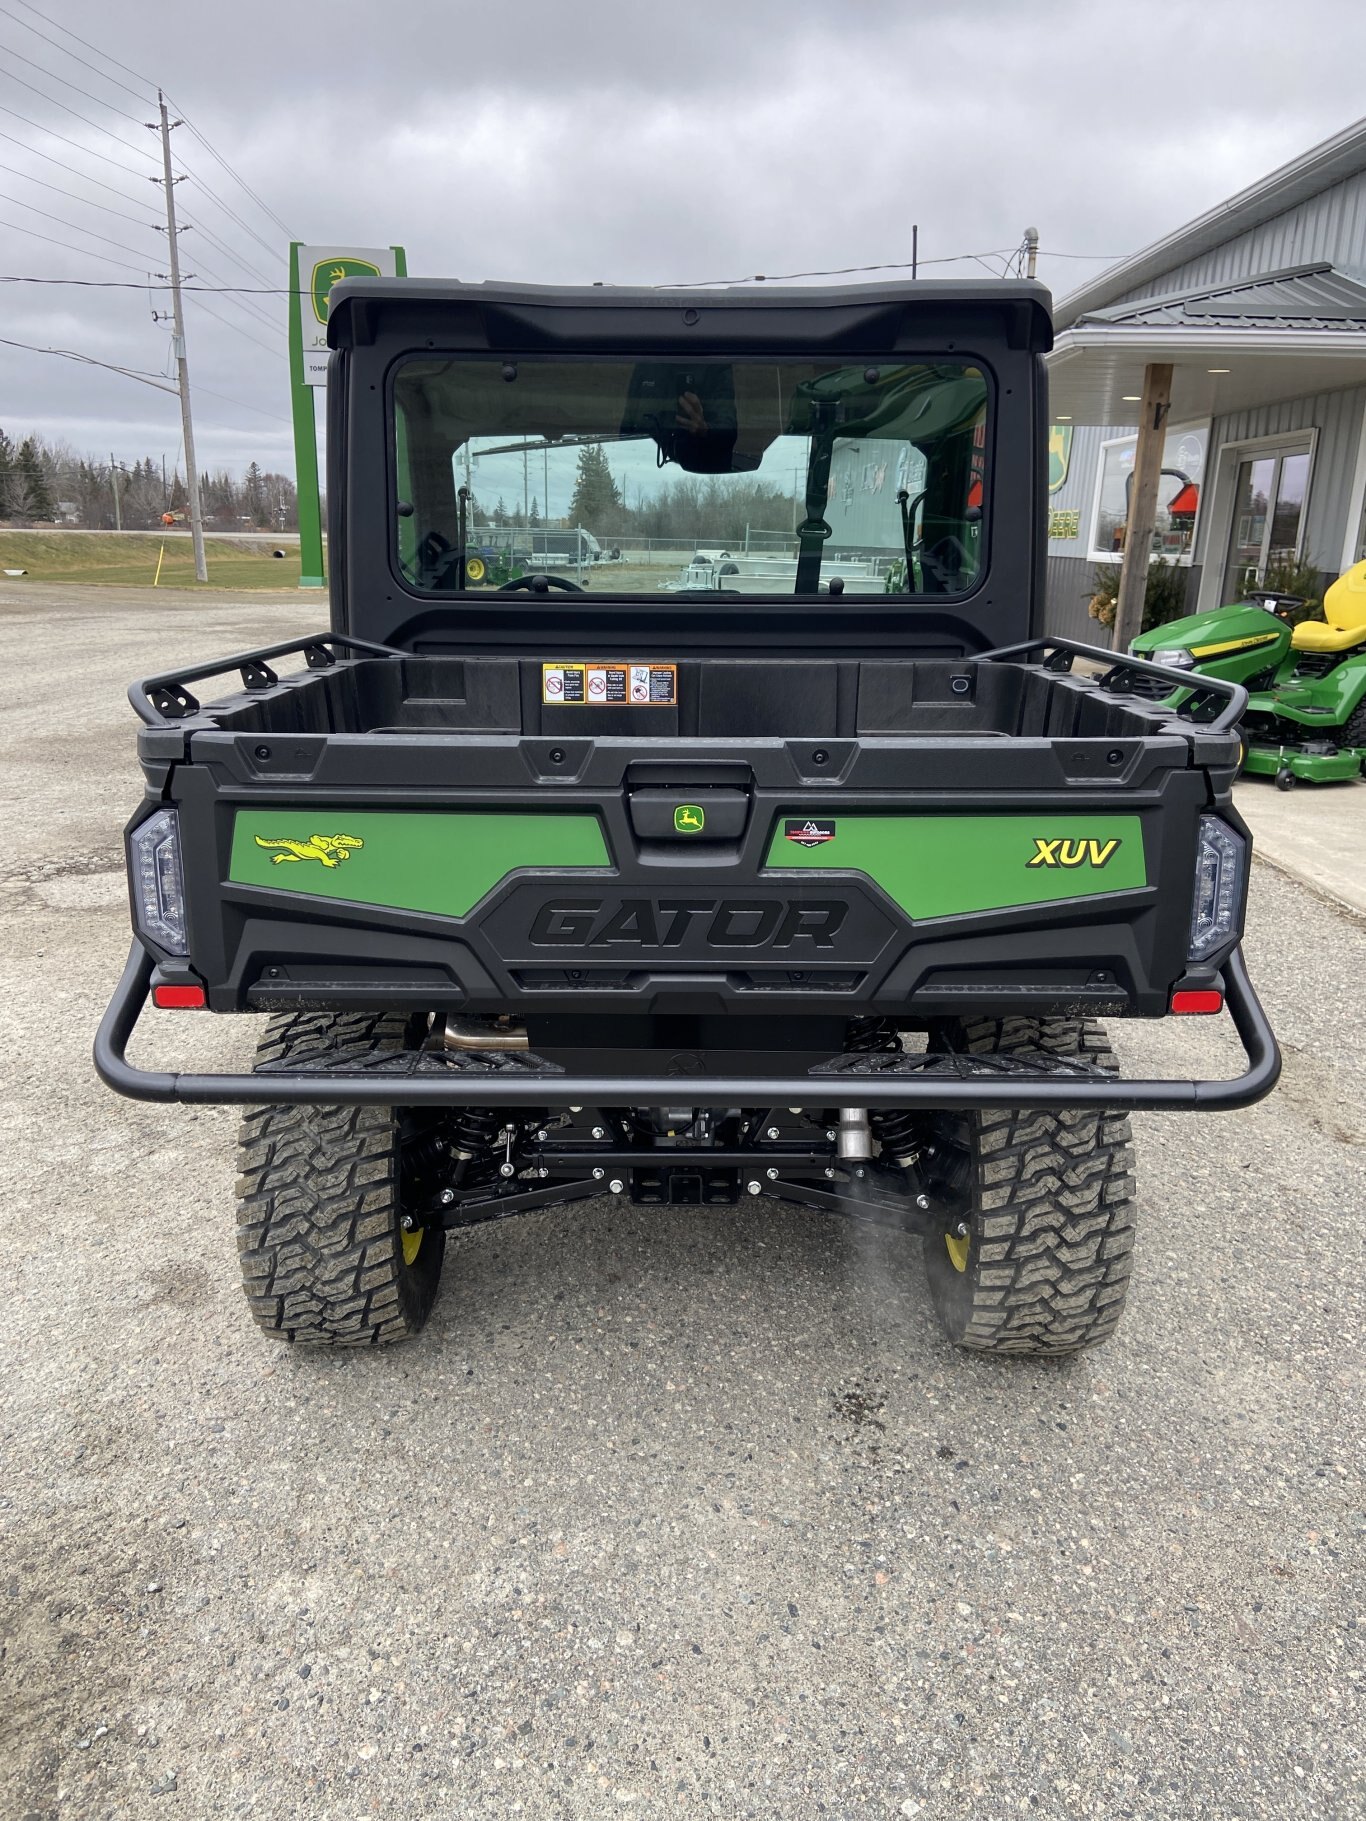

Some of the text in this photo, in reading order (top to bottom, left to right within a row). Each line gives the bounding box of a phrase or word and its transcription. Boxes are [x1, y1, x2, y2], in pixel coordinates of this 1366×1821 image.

[312, 336, 327, 346] Jo
[1025, 838, 1122, 868] XUV
[528, 899, 849, 949] GATOR
